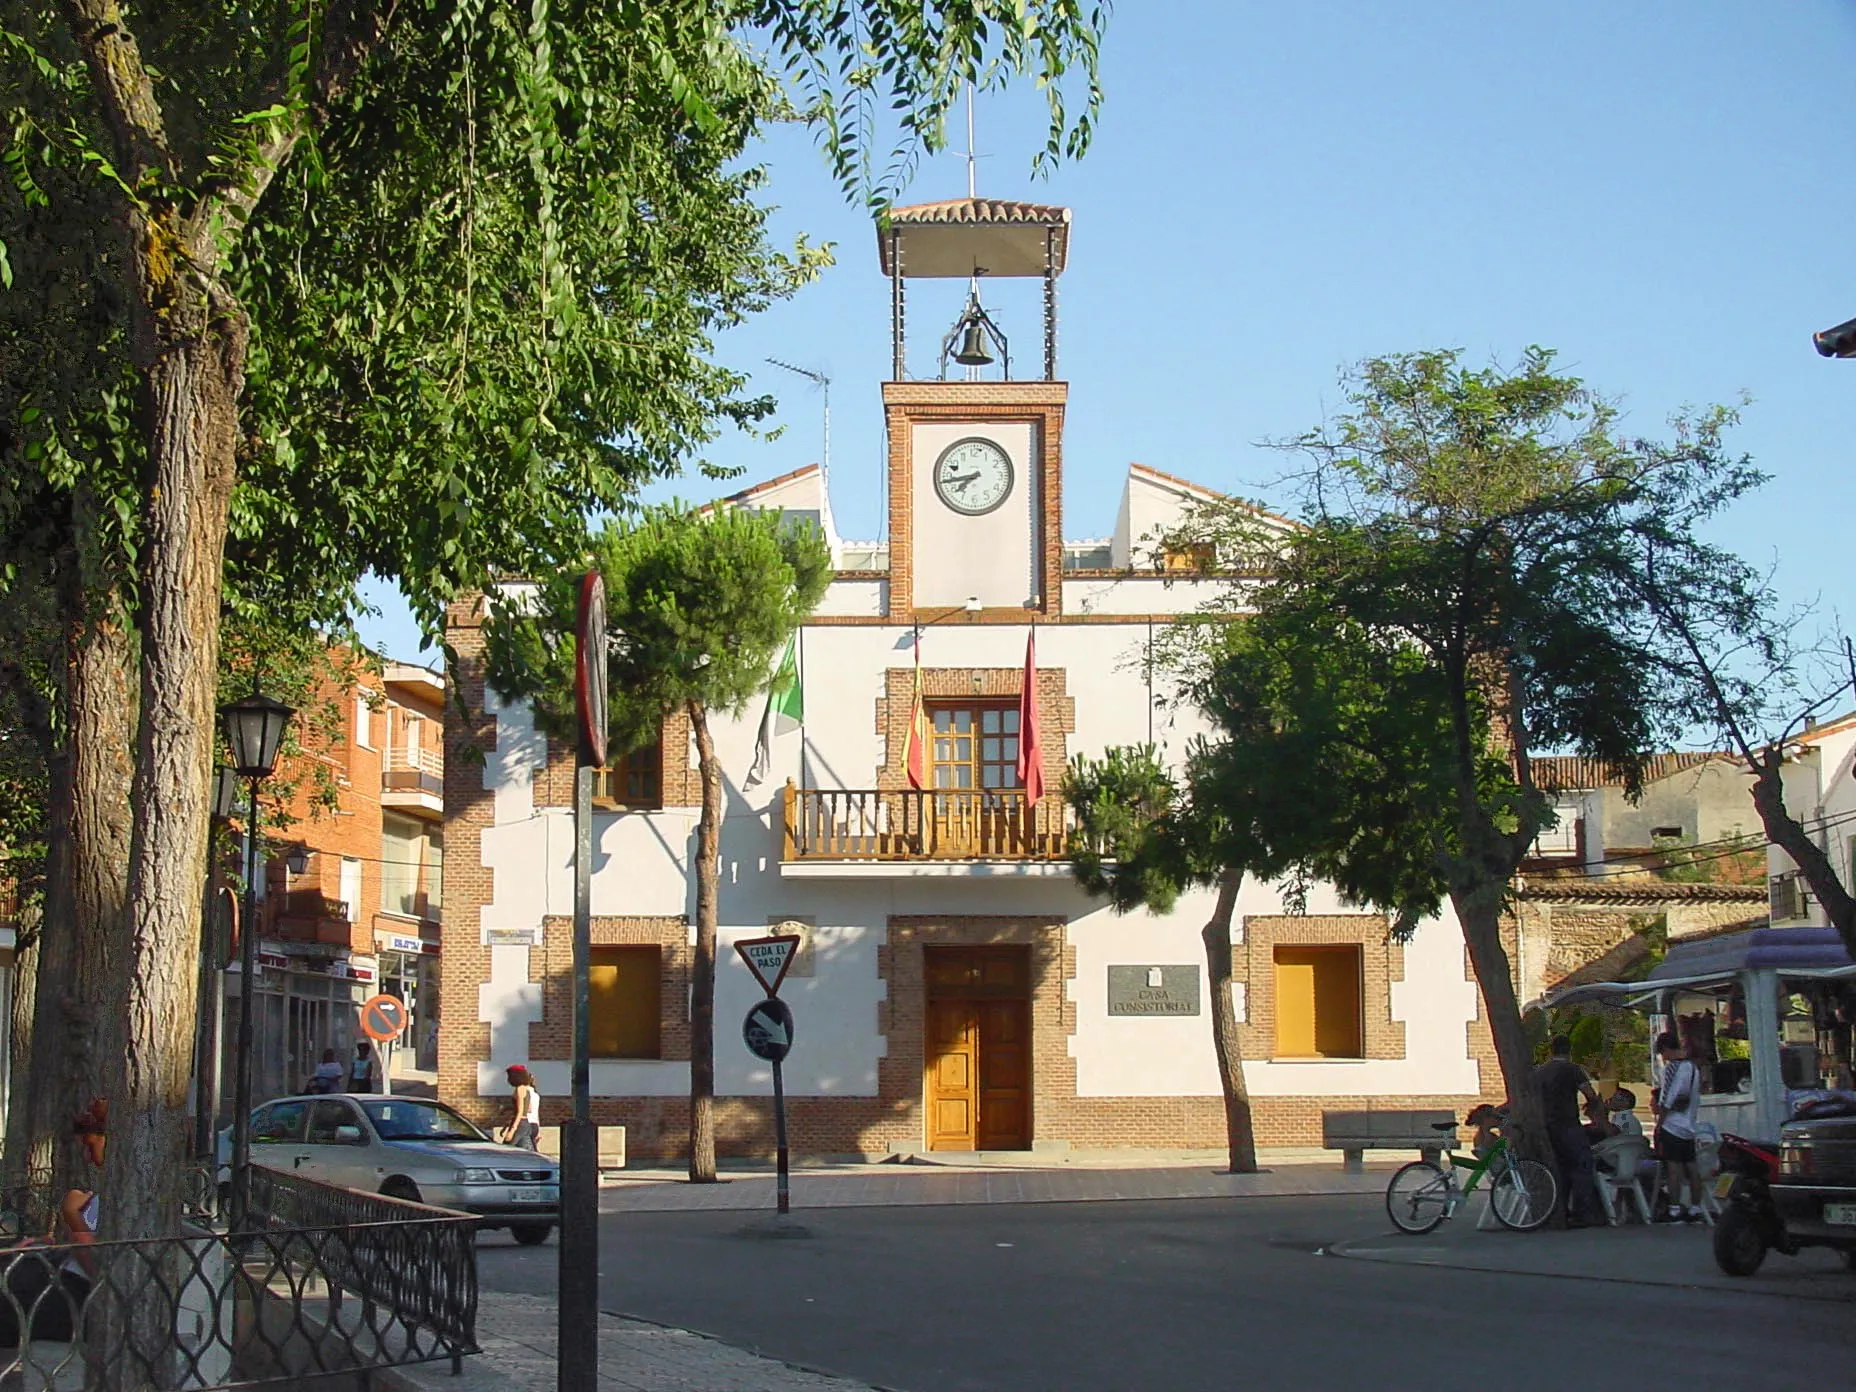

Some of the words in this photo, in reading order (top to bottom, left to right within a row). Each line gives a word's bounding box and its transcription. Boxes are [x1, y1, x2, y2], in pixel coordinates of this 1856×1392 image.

[992, 459, 1000, 469] 2
[750, 946, 773, 957] CEDA
[776, 945, 787, 955] EL
[758, 958, 782, 969] PASO
[1138, 990, 1169, 1000] CASA
